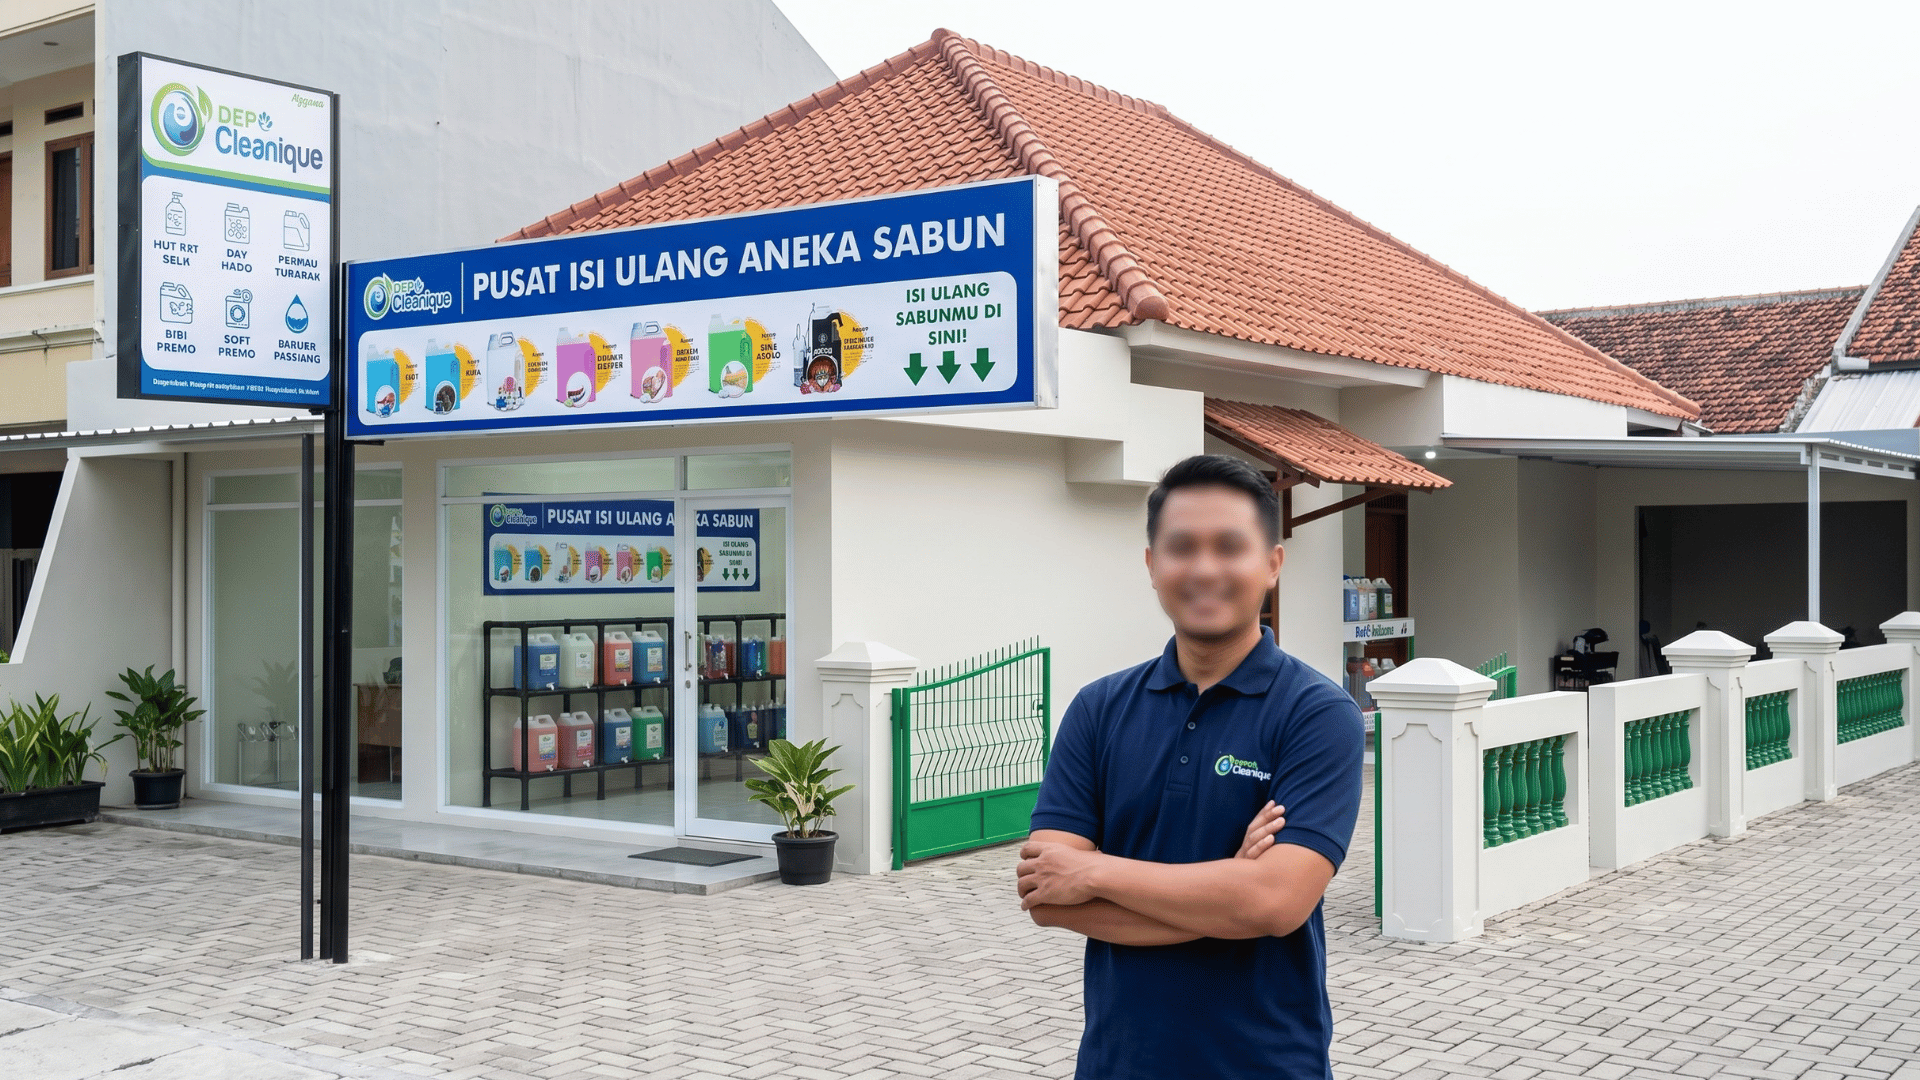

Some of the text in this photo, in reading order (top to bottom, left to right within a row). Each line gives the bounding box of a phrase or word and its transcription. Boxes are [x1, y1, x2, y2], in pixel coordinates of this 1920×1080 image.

[215, 126, 323, 173] Cleanique
[153, 239, 177, 251] HUT
[226, 248, 248, 259] DAY
[473, 213, 1005, 301] PUSAT ISI ULANG ANEKA SABUN
[163, 254, 190, 266] SELK
[278, 255, 318, 268] PERMAU
[221, 261, 252, 273] HADO
[275, 268, 321, 281] TURARAK
[906, 282, 990, 303] ISI ULANG
[392, 290, 451, 314] Cleanique
[896, 303, 1002, 326] SABUNMU DI
[165, 329, 187, 340] BIBI
[224, 334, 250, 346] SOFT
[928, 328, 967, 346] SINI!
[157, 342, 196, 354] PREMO
[278, 339, 316, 351] BARUER
[218, 347, 256, 359] PREMO
[274, 351, 321, 364] PASSIANG
[756, 352, 781, 360] ASOLO
[547, 508, 591, 525] PUSAT
[596, 510, 612, 525] ISI
[616, 511, 662, 526] ULANG
[712, 513, 753, 528] SABUN
